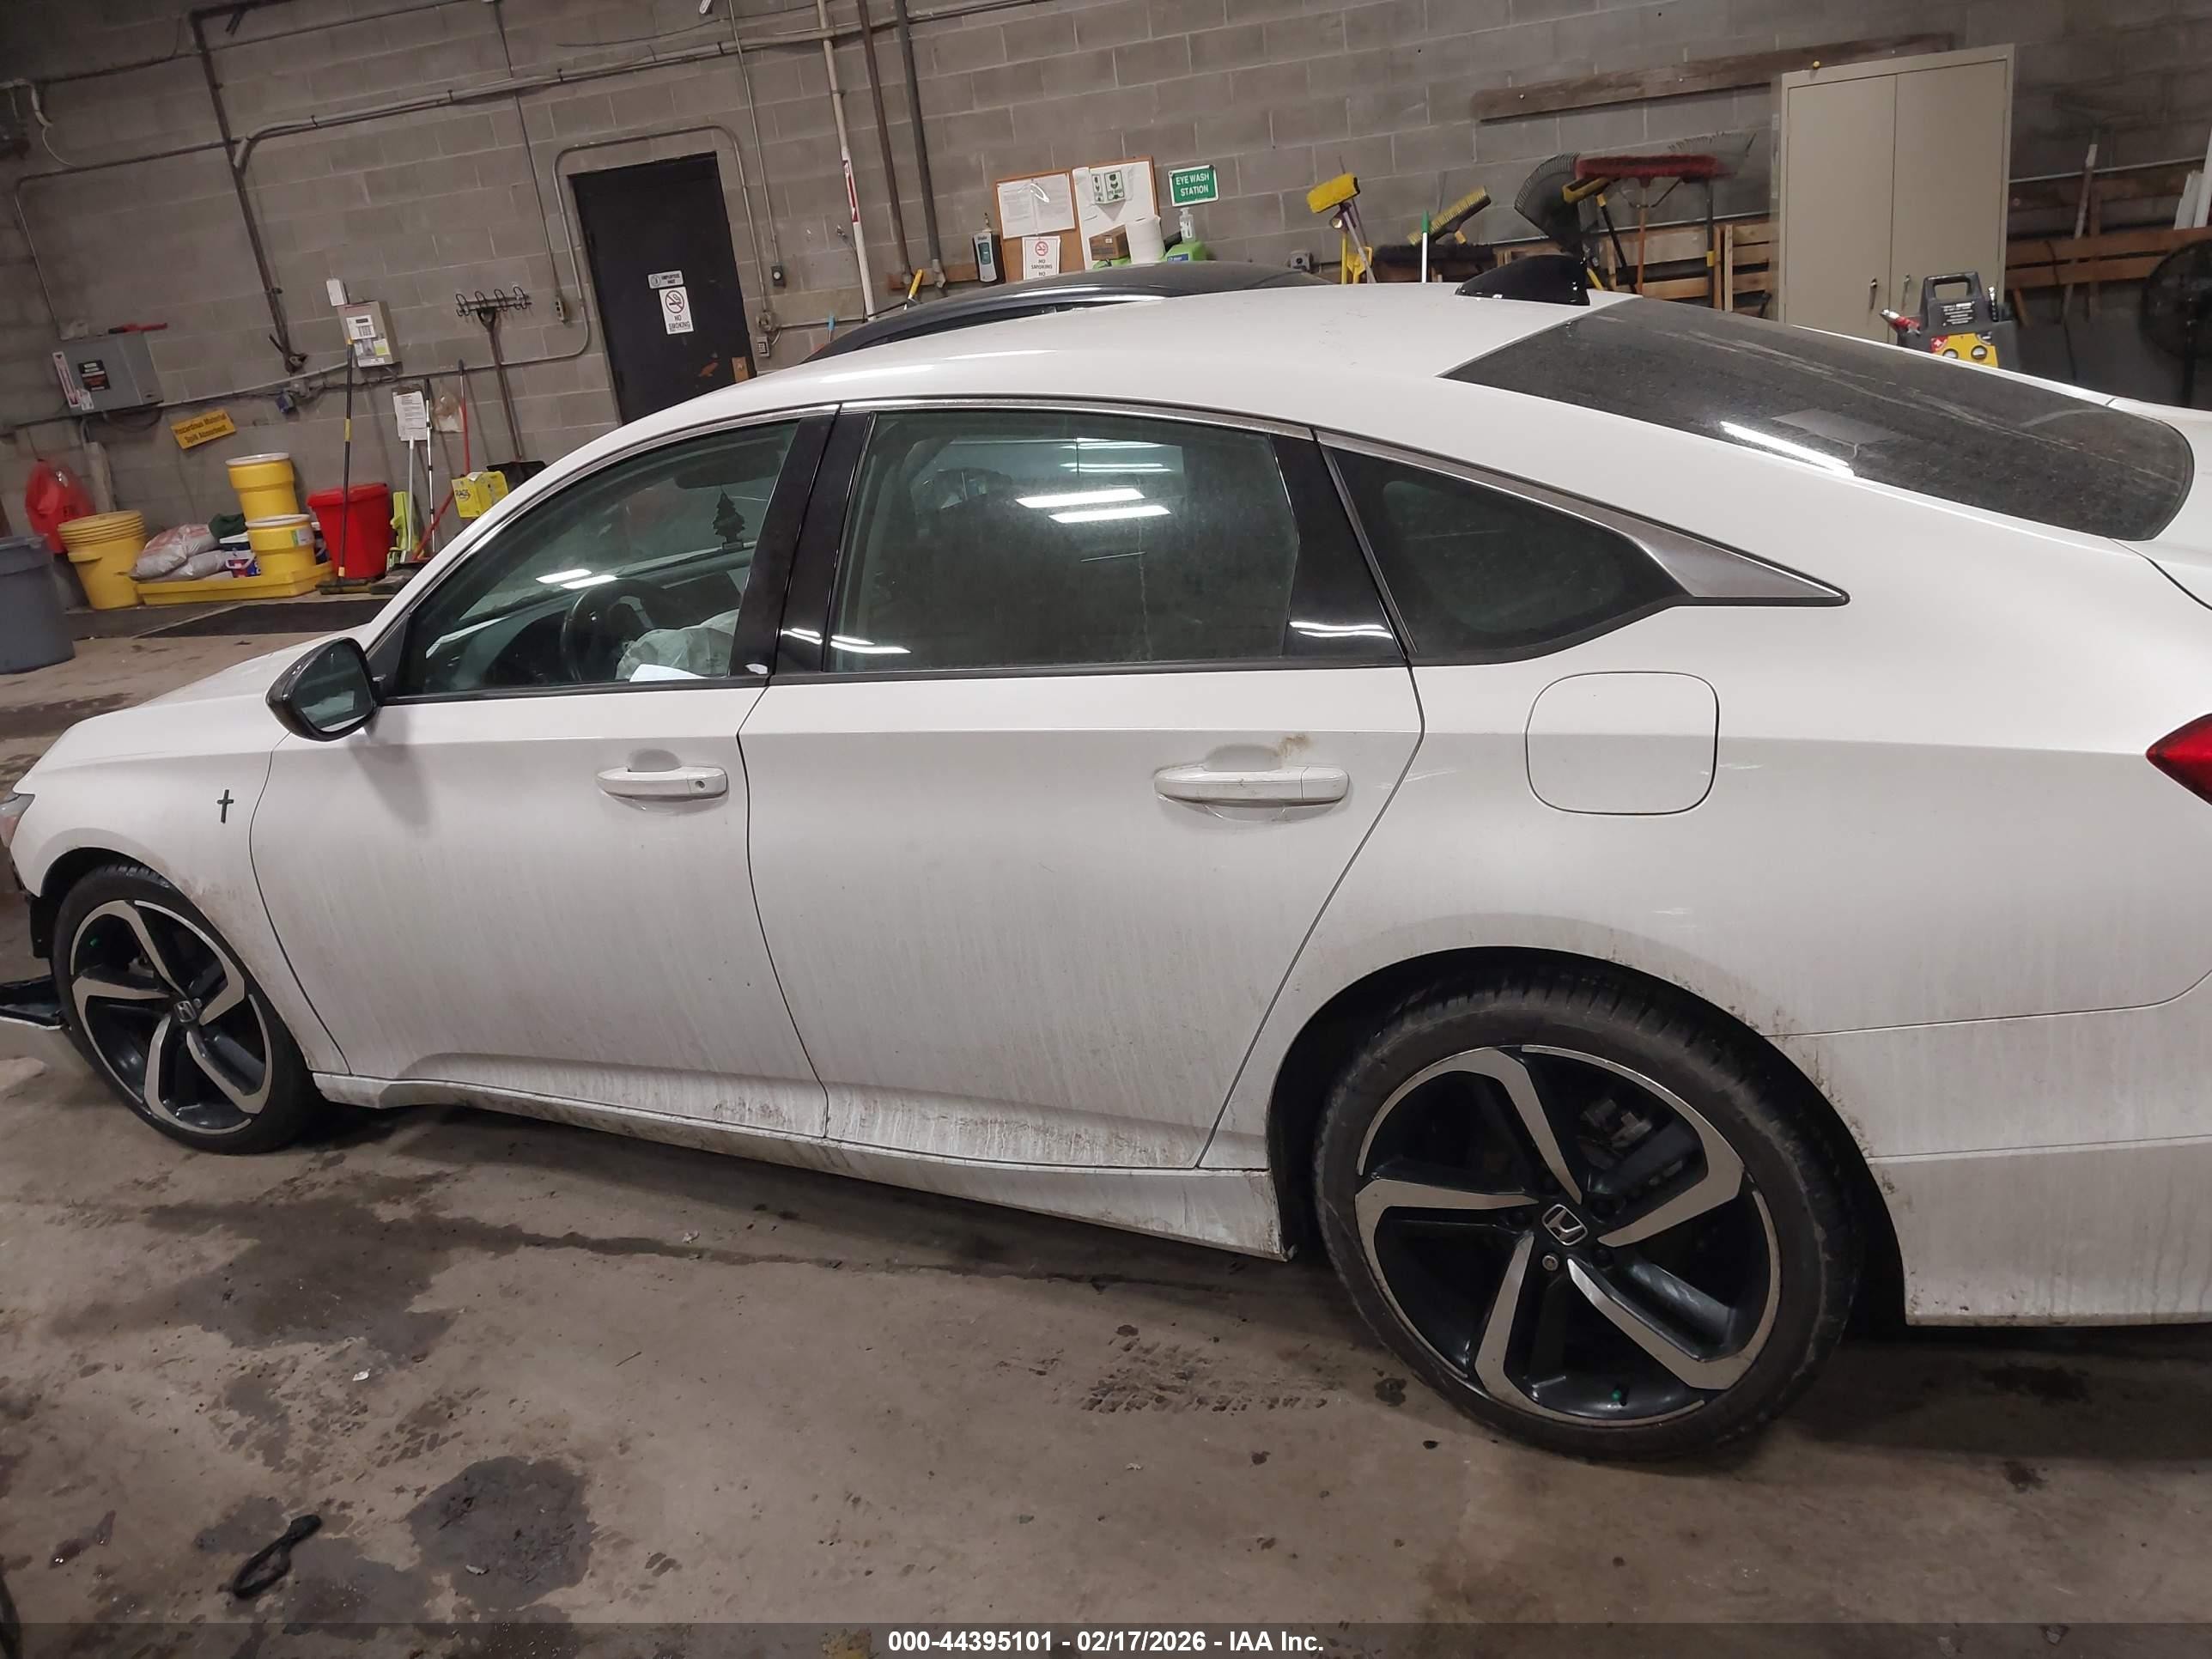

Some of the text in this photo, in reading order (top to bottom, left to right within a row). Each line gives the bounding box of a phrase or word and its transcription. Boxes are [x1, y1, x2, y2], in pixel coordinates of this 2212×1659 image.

[1176, 172, 1210, 185] EYE WASH
[1180, 184, 1209, 197] STATION
[668, 320, 691, 330] SMOKING
